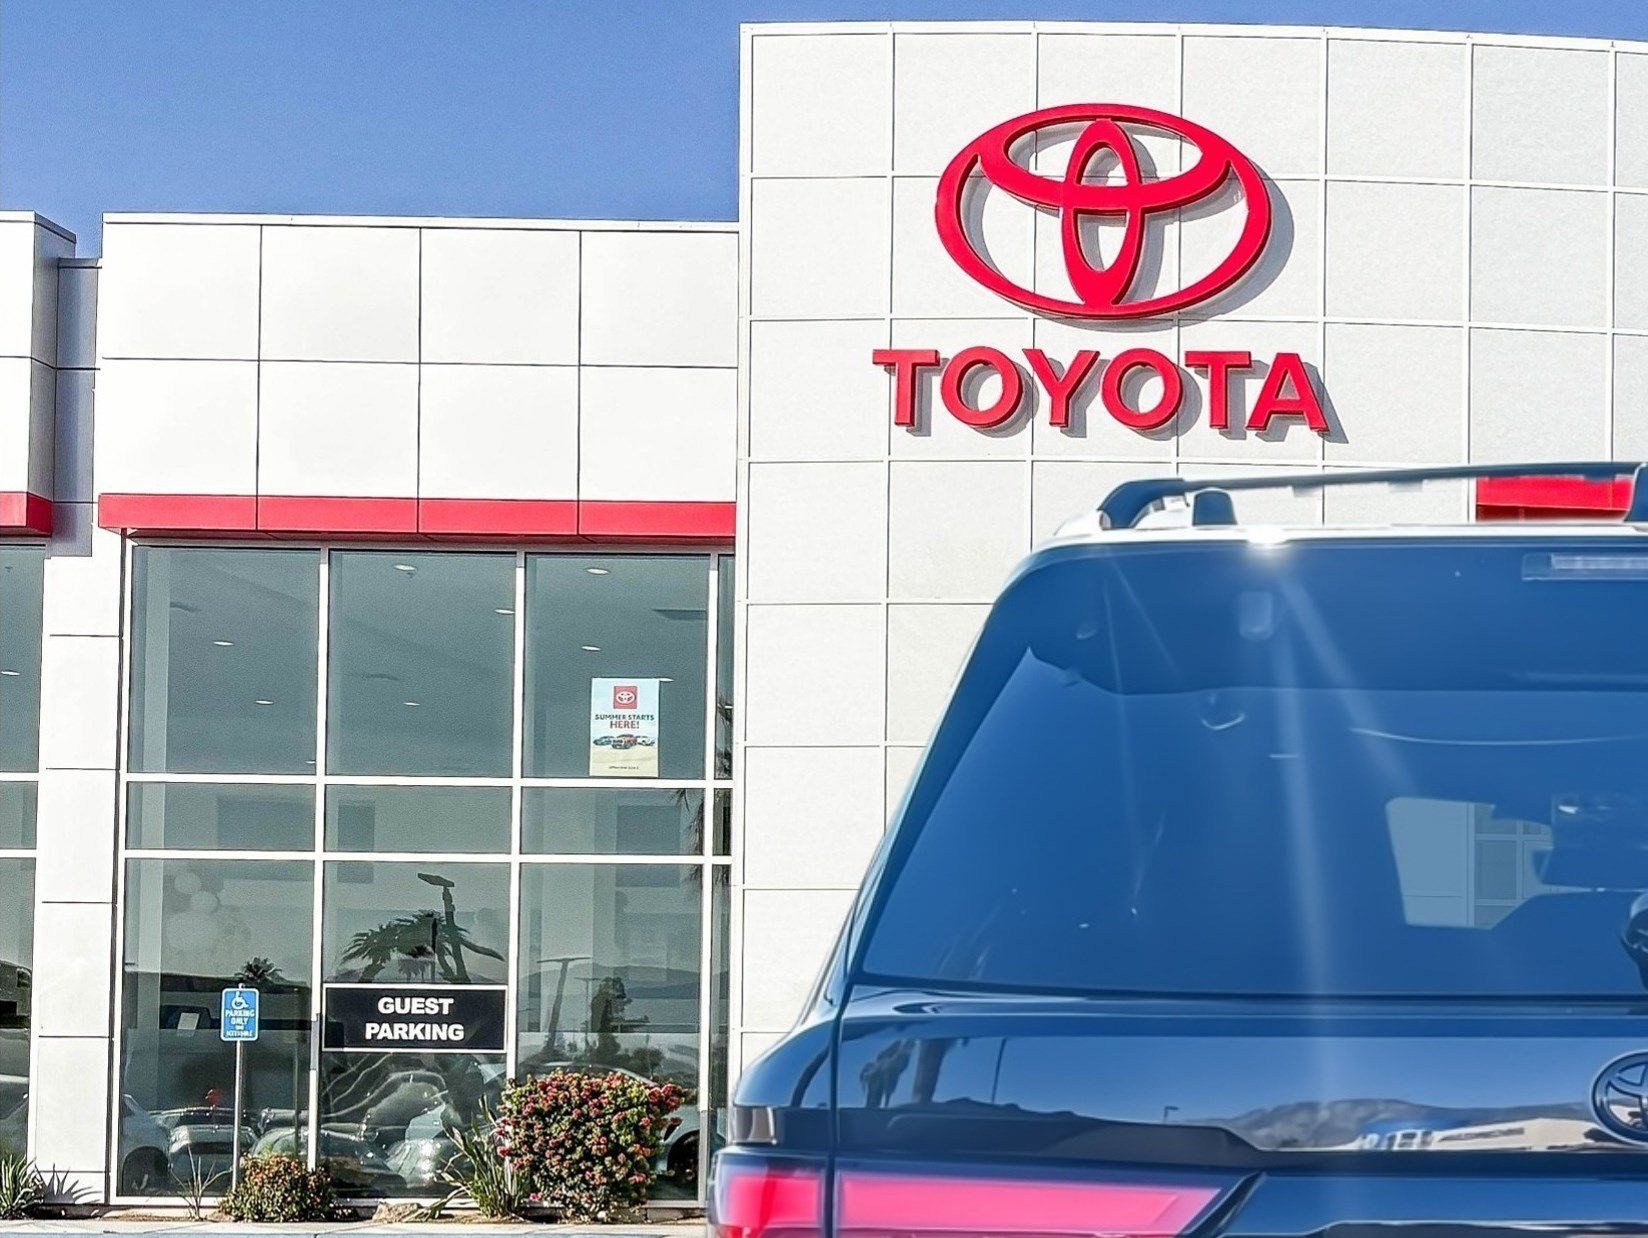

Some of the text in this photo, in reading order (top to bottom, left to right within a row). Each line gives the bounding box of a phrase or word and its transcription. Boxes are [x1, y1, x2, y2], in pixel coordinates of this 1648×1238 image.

[873, 346, 1329, 431] TOYOTA
[609, 720, 640, 729] HERE!
[377, 997, 454, 1015] GUEST
[365, 1022, 465, 1041] PARKING
